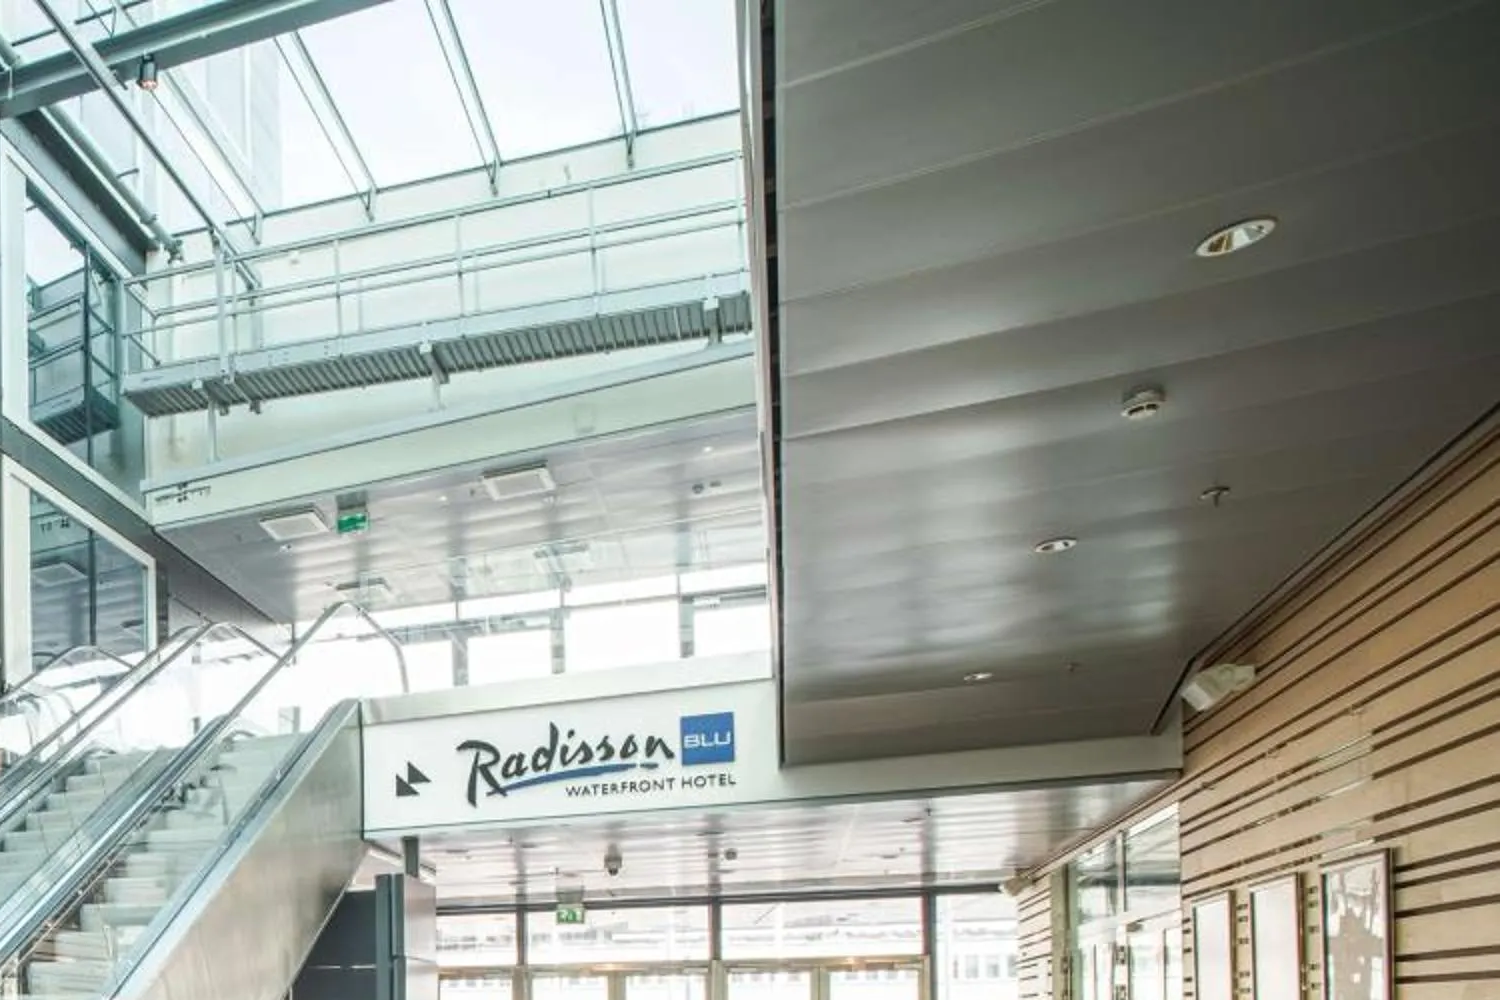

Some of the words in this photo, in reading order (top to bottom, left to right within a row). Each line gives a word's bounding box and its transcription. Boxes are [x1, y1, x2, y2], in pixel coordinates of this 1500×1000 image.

[457, 721, 675, 808] Radisson
[683, 731, 732, 749] BLU
[566, 777, 676, 797] WATERFRONT
[681, 773, 737, 788] HOTEL
